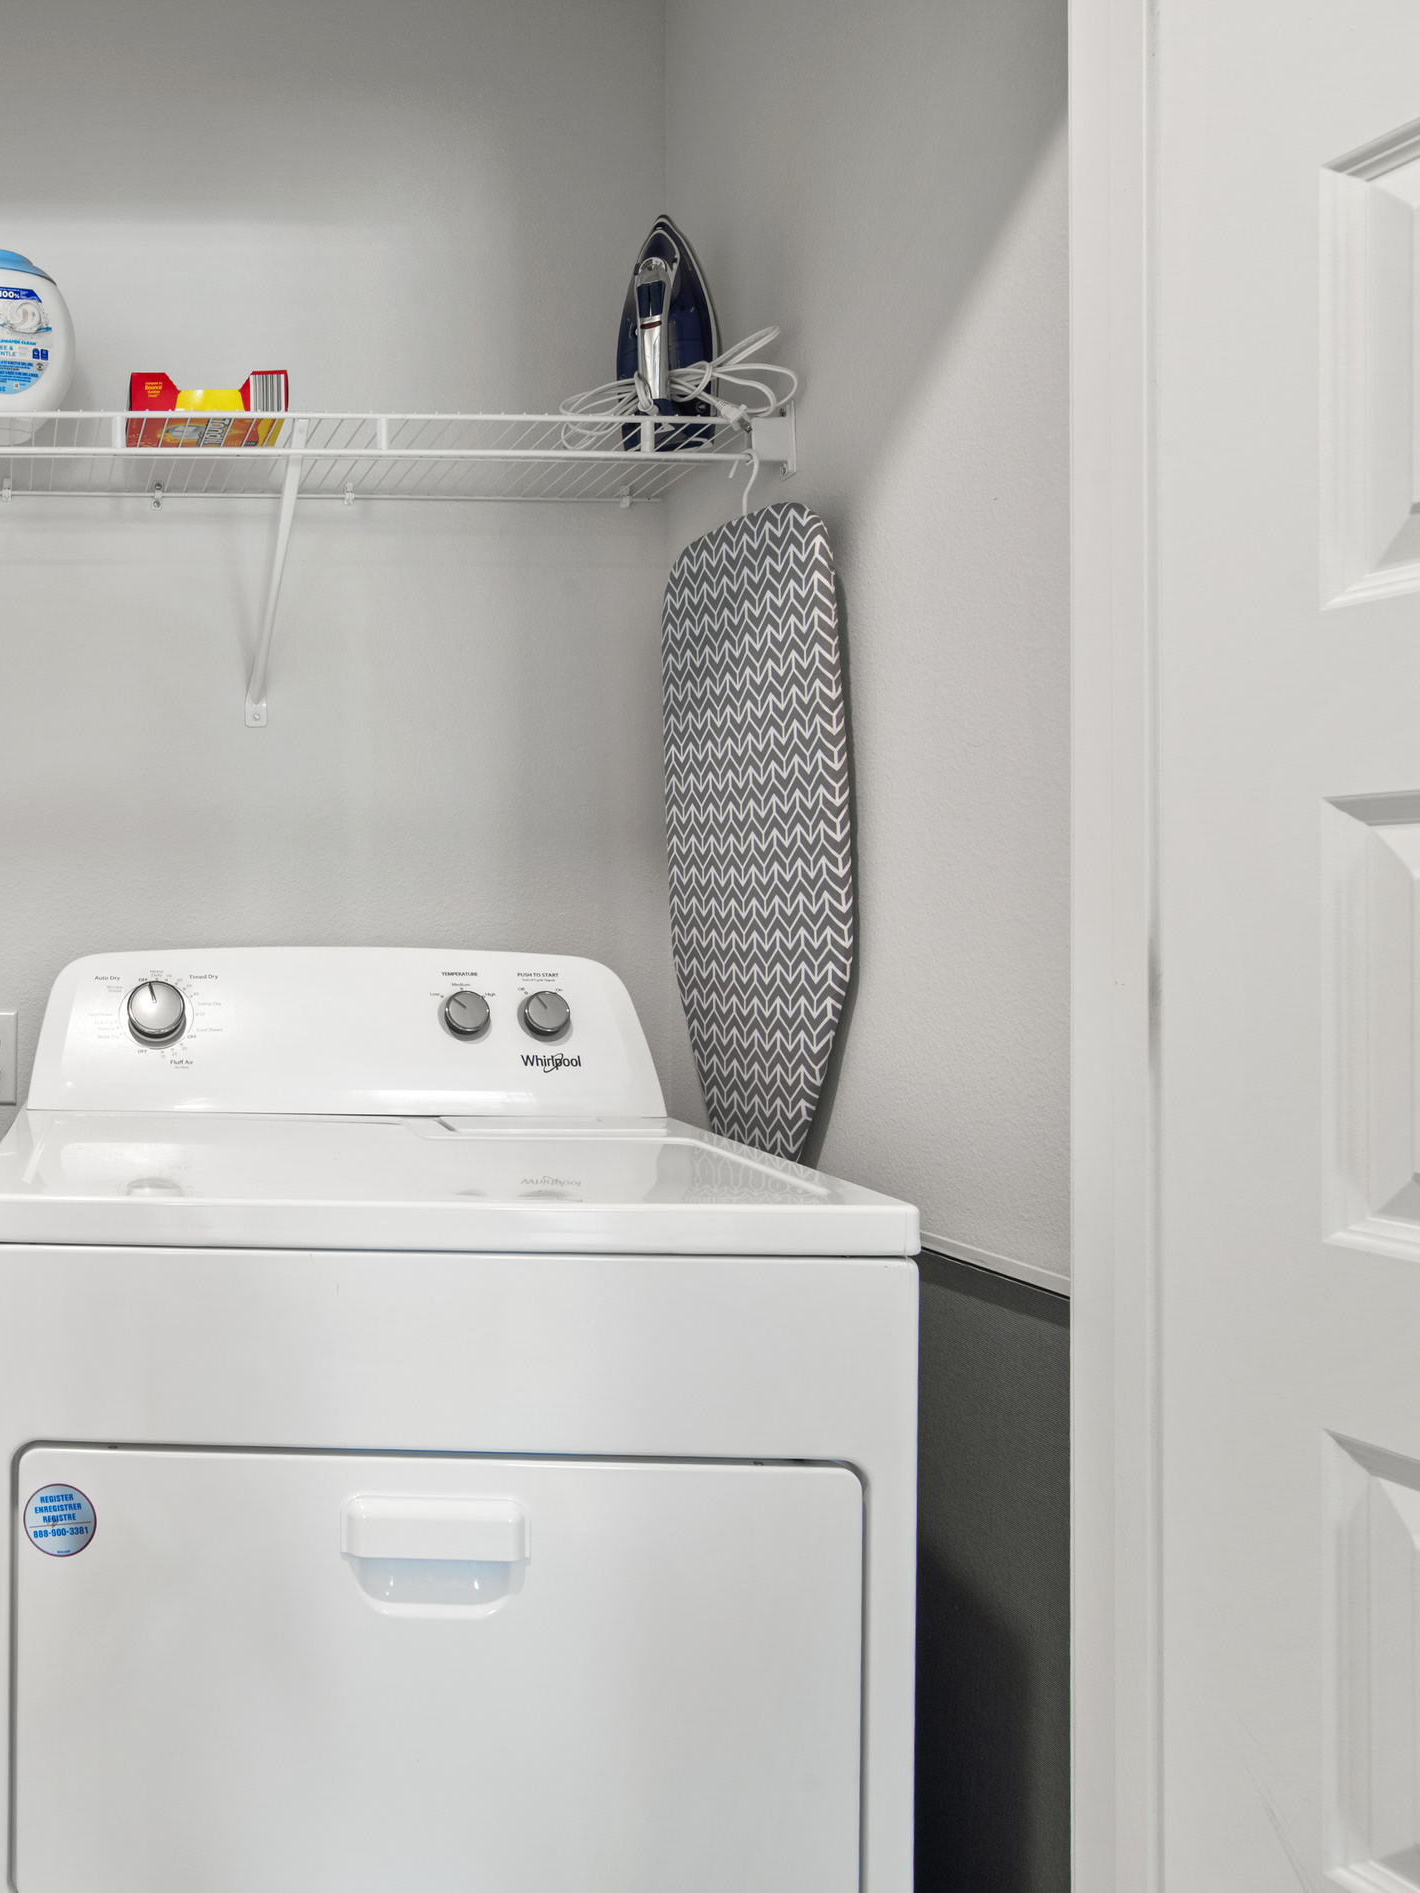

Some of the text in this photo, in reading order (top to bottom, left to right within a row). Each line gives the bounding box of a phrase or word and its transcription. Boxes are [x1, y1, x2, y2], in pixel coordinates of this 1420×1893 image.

[521, 1053, 582, 1072] Whirlpool
[40, 1493, 74, 1504] REGISTER
[34, 1503, 82, 1514] ENREGISTRER
[42, 1513, 76, 1523] REGISTRE
[33, 1526, 89, 1539] 888-900-3381
